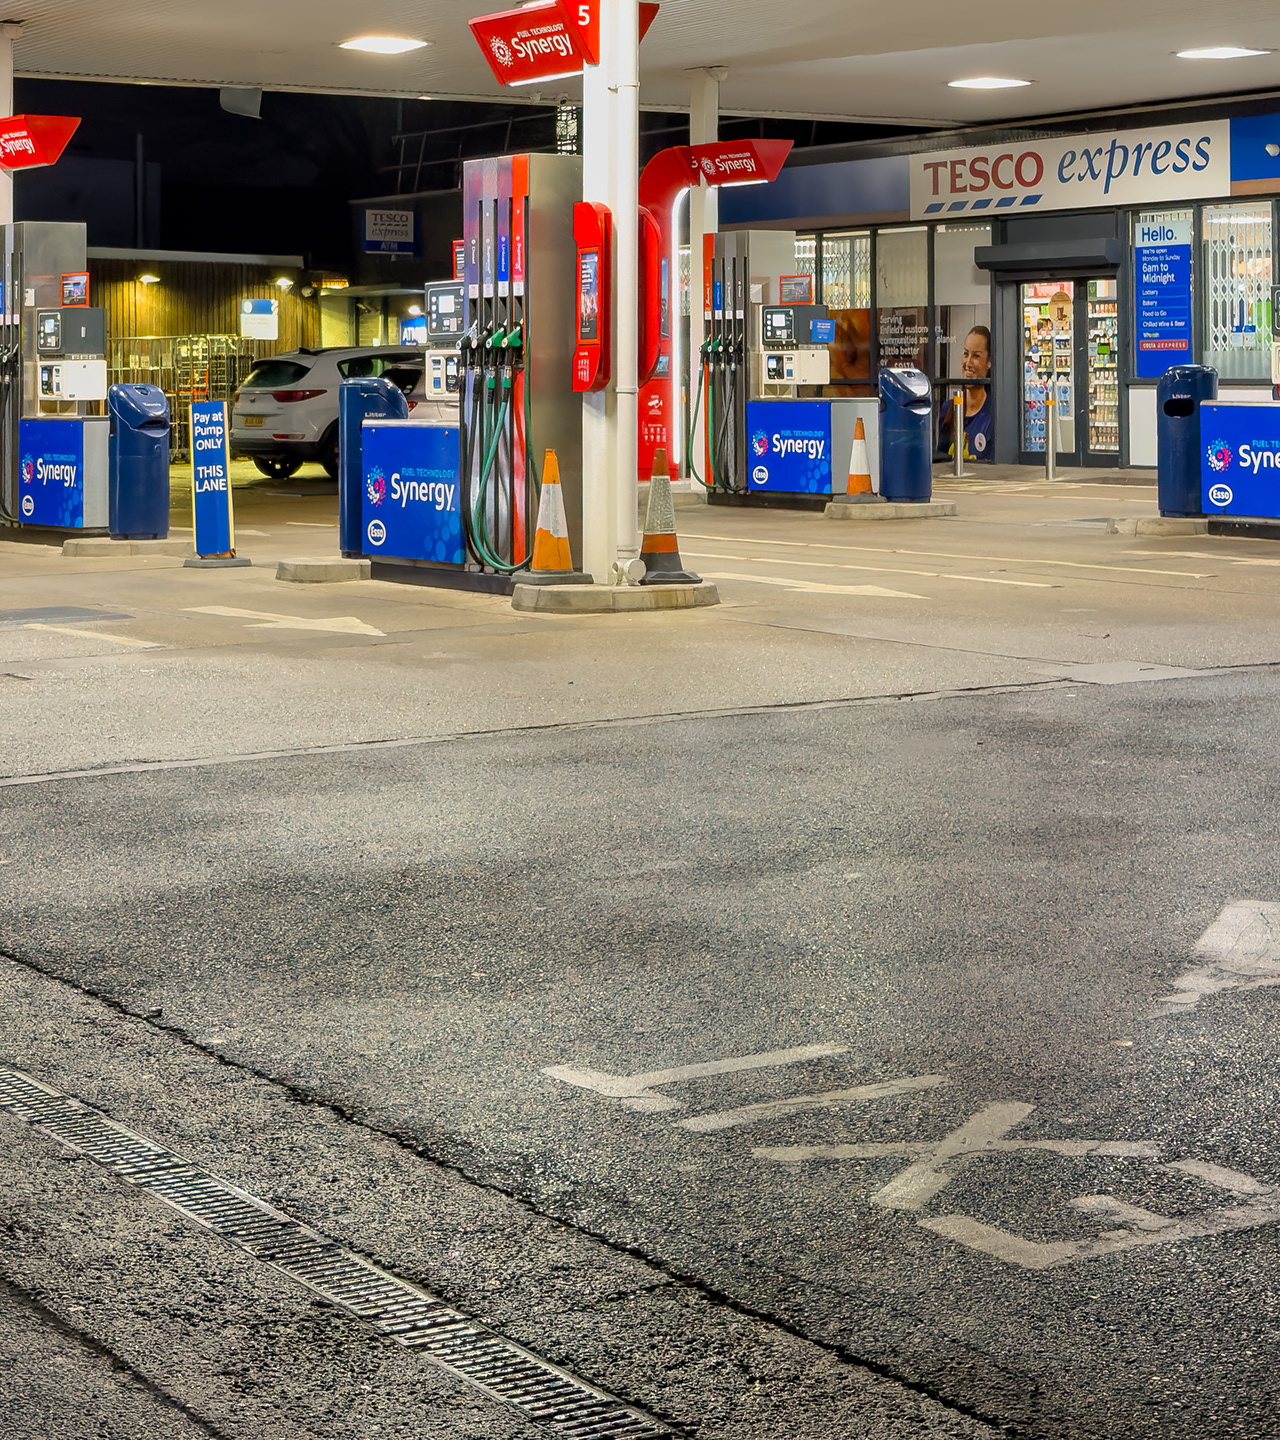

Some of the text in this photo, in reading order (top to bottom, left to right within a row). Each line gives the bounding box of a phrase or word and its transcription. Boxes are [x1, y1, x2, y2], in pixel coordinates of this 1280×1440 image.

[577, 4, 591, 27] 5
[511, 33, 574, 63] Synergy
[0, 137, 36, 157] Synergy
[715, 157, 757, 175] Synergy
[923, 135, 1212, 196] TESCO express
[371, 212, 409, 223] TESCO
[371, 227, 410, 239] express
[1141, 225, 1177, 242] Hello.
[380, 241, 398, 251] ATM
[1142, 262, 1169, 273] 6am to
[1142, 273, 1176, 285] Midnight
[880, 315, 903, 325] Serving
[900, 346, 920, 356] better
[193, 411, 224, 425] Pay at
[194, 425, 224, 438] Pump
[195, 438, 223, 451] ONLY
[772, 433, 825, 459] Synergy
[1252, 439, 1270, 448] FUEL
[36, 457, 77, 488] Synergy
[196, 464, 224, 479] THIS
[401, 467, 455, 479] FUEL TECHNOLOGY
[195, 478, 228, 493] LANE
[391, 473, 455, 512] Synergy
